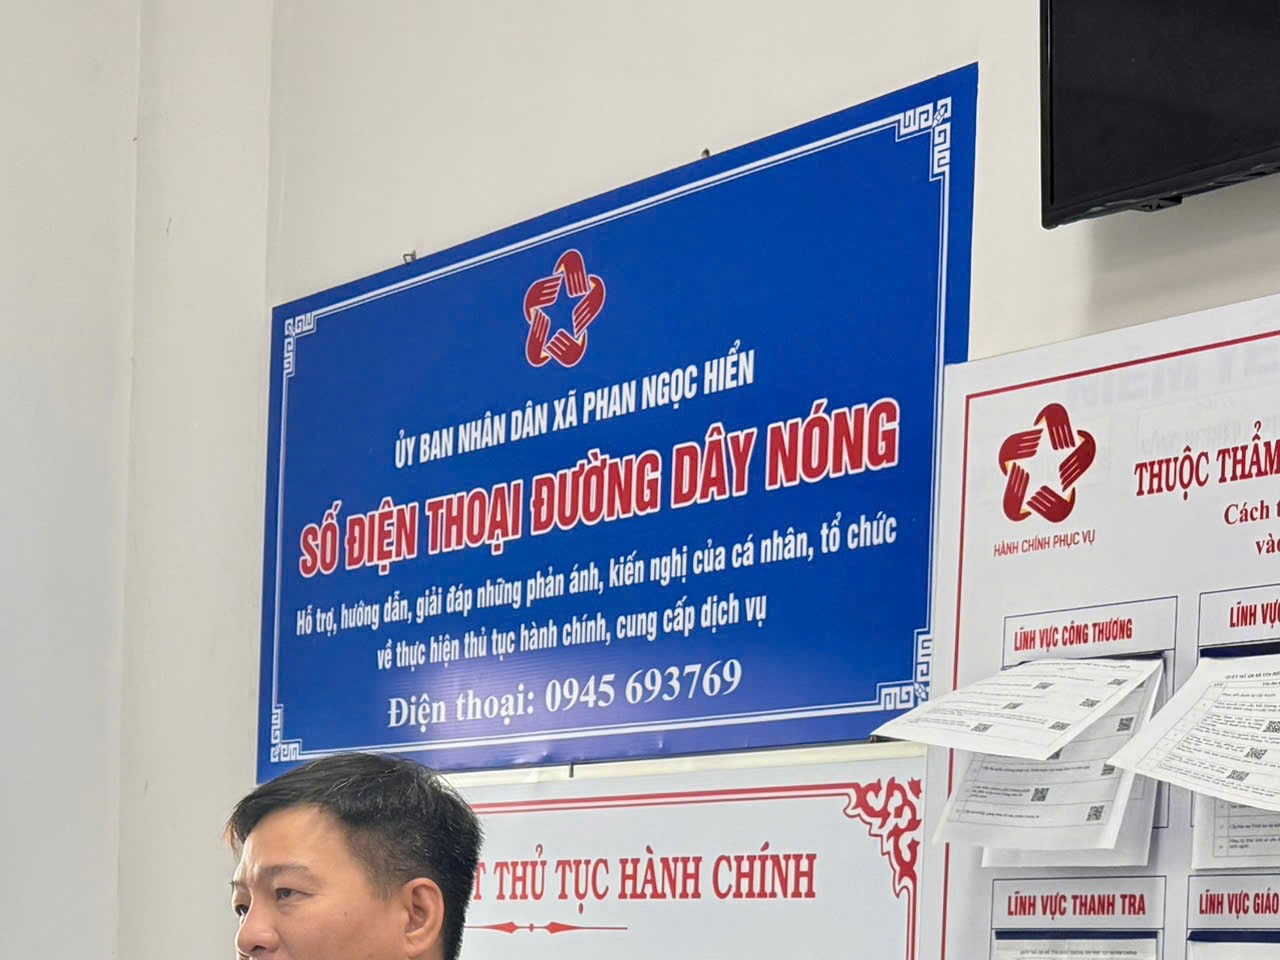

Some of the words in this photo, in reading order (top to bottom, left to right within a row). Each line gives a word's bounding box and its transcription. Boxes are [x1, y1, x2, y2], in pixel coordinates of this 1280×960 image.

[395, 428, 416, 468] ỦY
[419, 426, 454, 464] BAN
[458, 411, 506, 453] NHÂN
[510, 400, 548, 441] DÂN
[553, 389, 577, 432] XÃ
[582, 380, 636, 424] PHAN
[641, 364, 698, 410] NGỌC
[704, 339, 755, 395] HIỂN
[299, 500, 342, 578] SỐ
[345, 496, 419, 576] ĐIỆN
[425, 480, 523, 555] THOẠI
[530, 448, 661, 535] ĐƯỜNG
[670, 421, 758, 509] DÂY
[765, 396, 900, 491] NÓNG
[1134, 445, 1210, 501] THUỘC
[1224, 501, 1270, 525] Cách
[993, 540, 1019, 557] HÀNH
[1021, 534, 1050, 553] CHÍNH
[1053, 531, 1080, 549] PHỤC
[1082, 529, 1096, 546] VỤ
[316, 607, 337, 637] trợ,
[384, 590, 412, 624] dẫn,
[416, 585, 442, 624] giải
[446, 583, 472, 616] đáp
[477, 577, 521, 609] những
[527, 566, 565, 607] phản
[569, 561, 604, 595] ánh,
[609, 550, 644, 588] kiến
[650, 545, 687, 587] nghị
[693, 538, 725, 575] của
[731, 533, 754, 566] cá
[760, 526, 814, 564] nhân,
[820, 511, 841, 554] tổ
[847, 511, 897, 550] chức
[377, 638, 392, 670] về
[396, 640, 426, 672] thực
[429, 633, 459, 669] hiện
[464, 626, 487, 659] thủ
[491, 628, 515, 662] tục
[520, 618, 557, 652] hành
[562, 612, 611, 645] chính,
[616, 610, 658, 642] cung
[663, 595, 695, 637] cấp
[700, 593, 739, 633] dịch
[745, 594, 767, 627] vụ
[1014, 627, 1036, 651] LĨNH
[1039, 625, 1059, 652] VỰC
[1062, 620, 1089, 646] CÔNG
[1092, 618, 1133, 643] THƯƠNG
[1230, 601, 1257, 628] LĨNH
[387, 693, 447, 733] Điện
[455, 683, 534, 726] thoại:
[545, 672, 616, 712] 0945
[625, 658, 743, 705] 693769
[494, 843, 548, 900] THỦ
[555, 858, 609, 914] TỤC
[618, 845, 703, 900] HÀNH
[712, 841, 817, 900] CHÍNH
[1007, 891, 1036, 917] LĨNH
[1041, 891, 1067, 920] VỰC
[1071, 893, 1118, 917] THANH
[1120, 893, 1147, 916] TRA
[1199, 888, 1224, 915] LĨNH
[1228, 890, 1250, 919] VỰC
[1253, 888, 1280, 915] GIÁO
